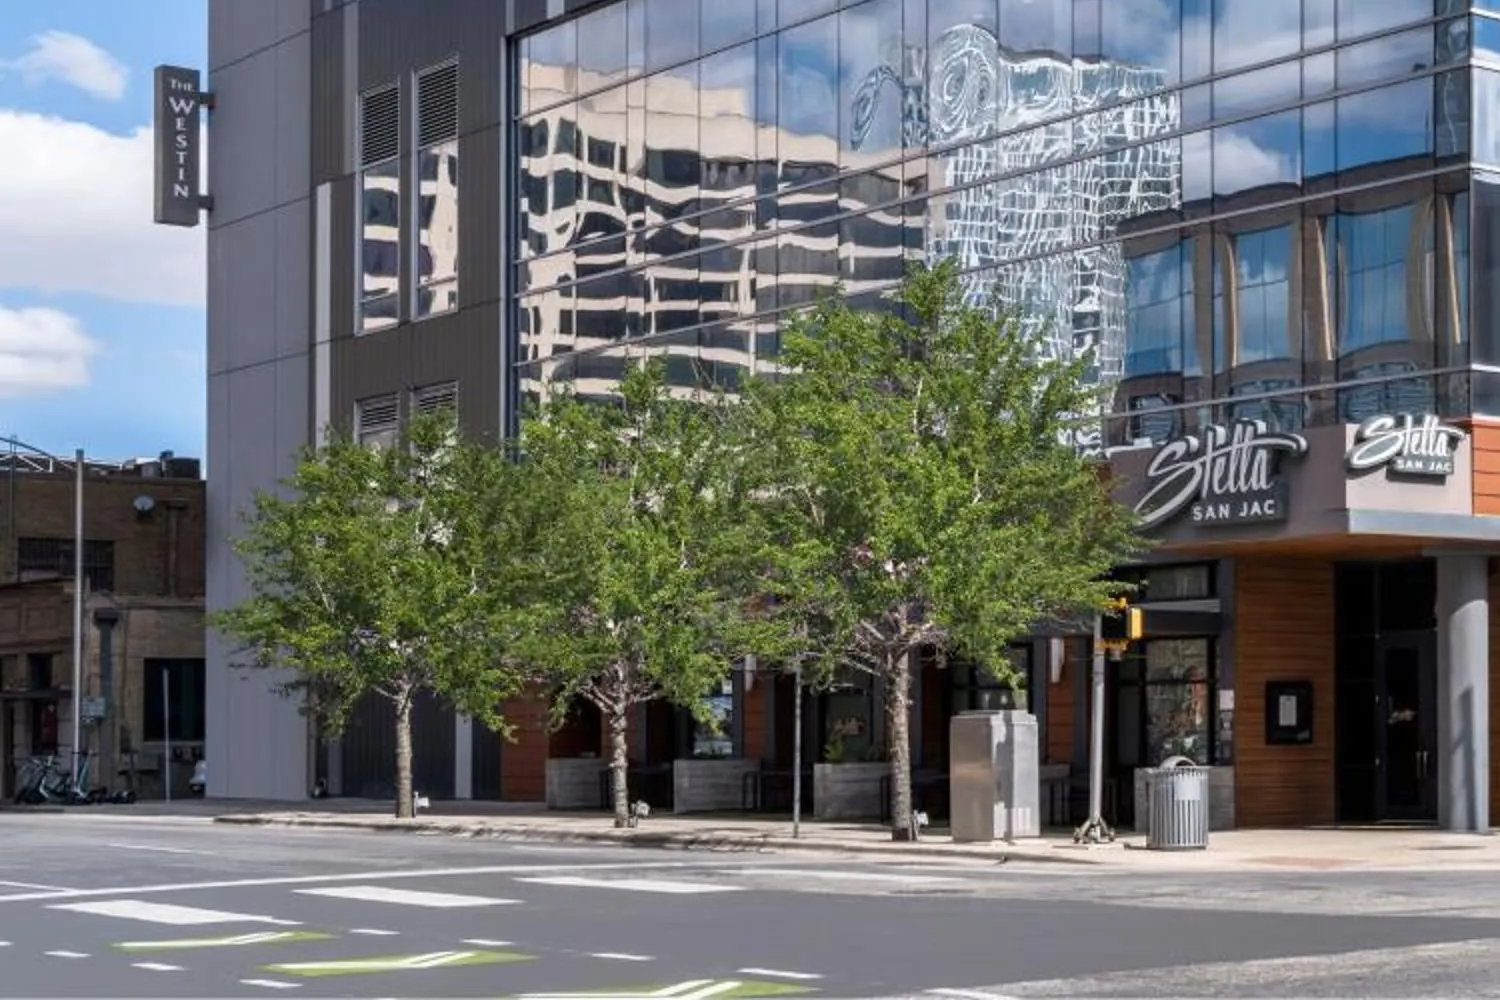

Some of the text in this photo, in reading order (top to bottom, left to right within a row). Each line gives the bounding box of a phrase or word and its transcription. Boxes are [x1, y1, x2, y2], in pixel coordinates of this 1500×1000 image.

[169, 77, 193, 93] THE
[169, 96, 195, 198] WESTIN
[1351, 413, 1466, 469] Stella
[1134, 421, 1300, 526] Stella
[1396, 459, 1424, 470] SAN
[1192, 499, 1276, 521] SAN JAC
